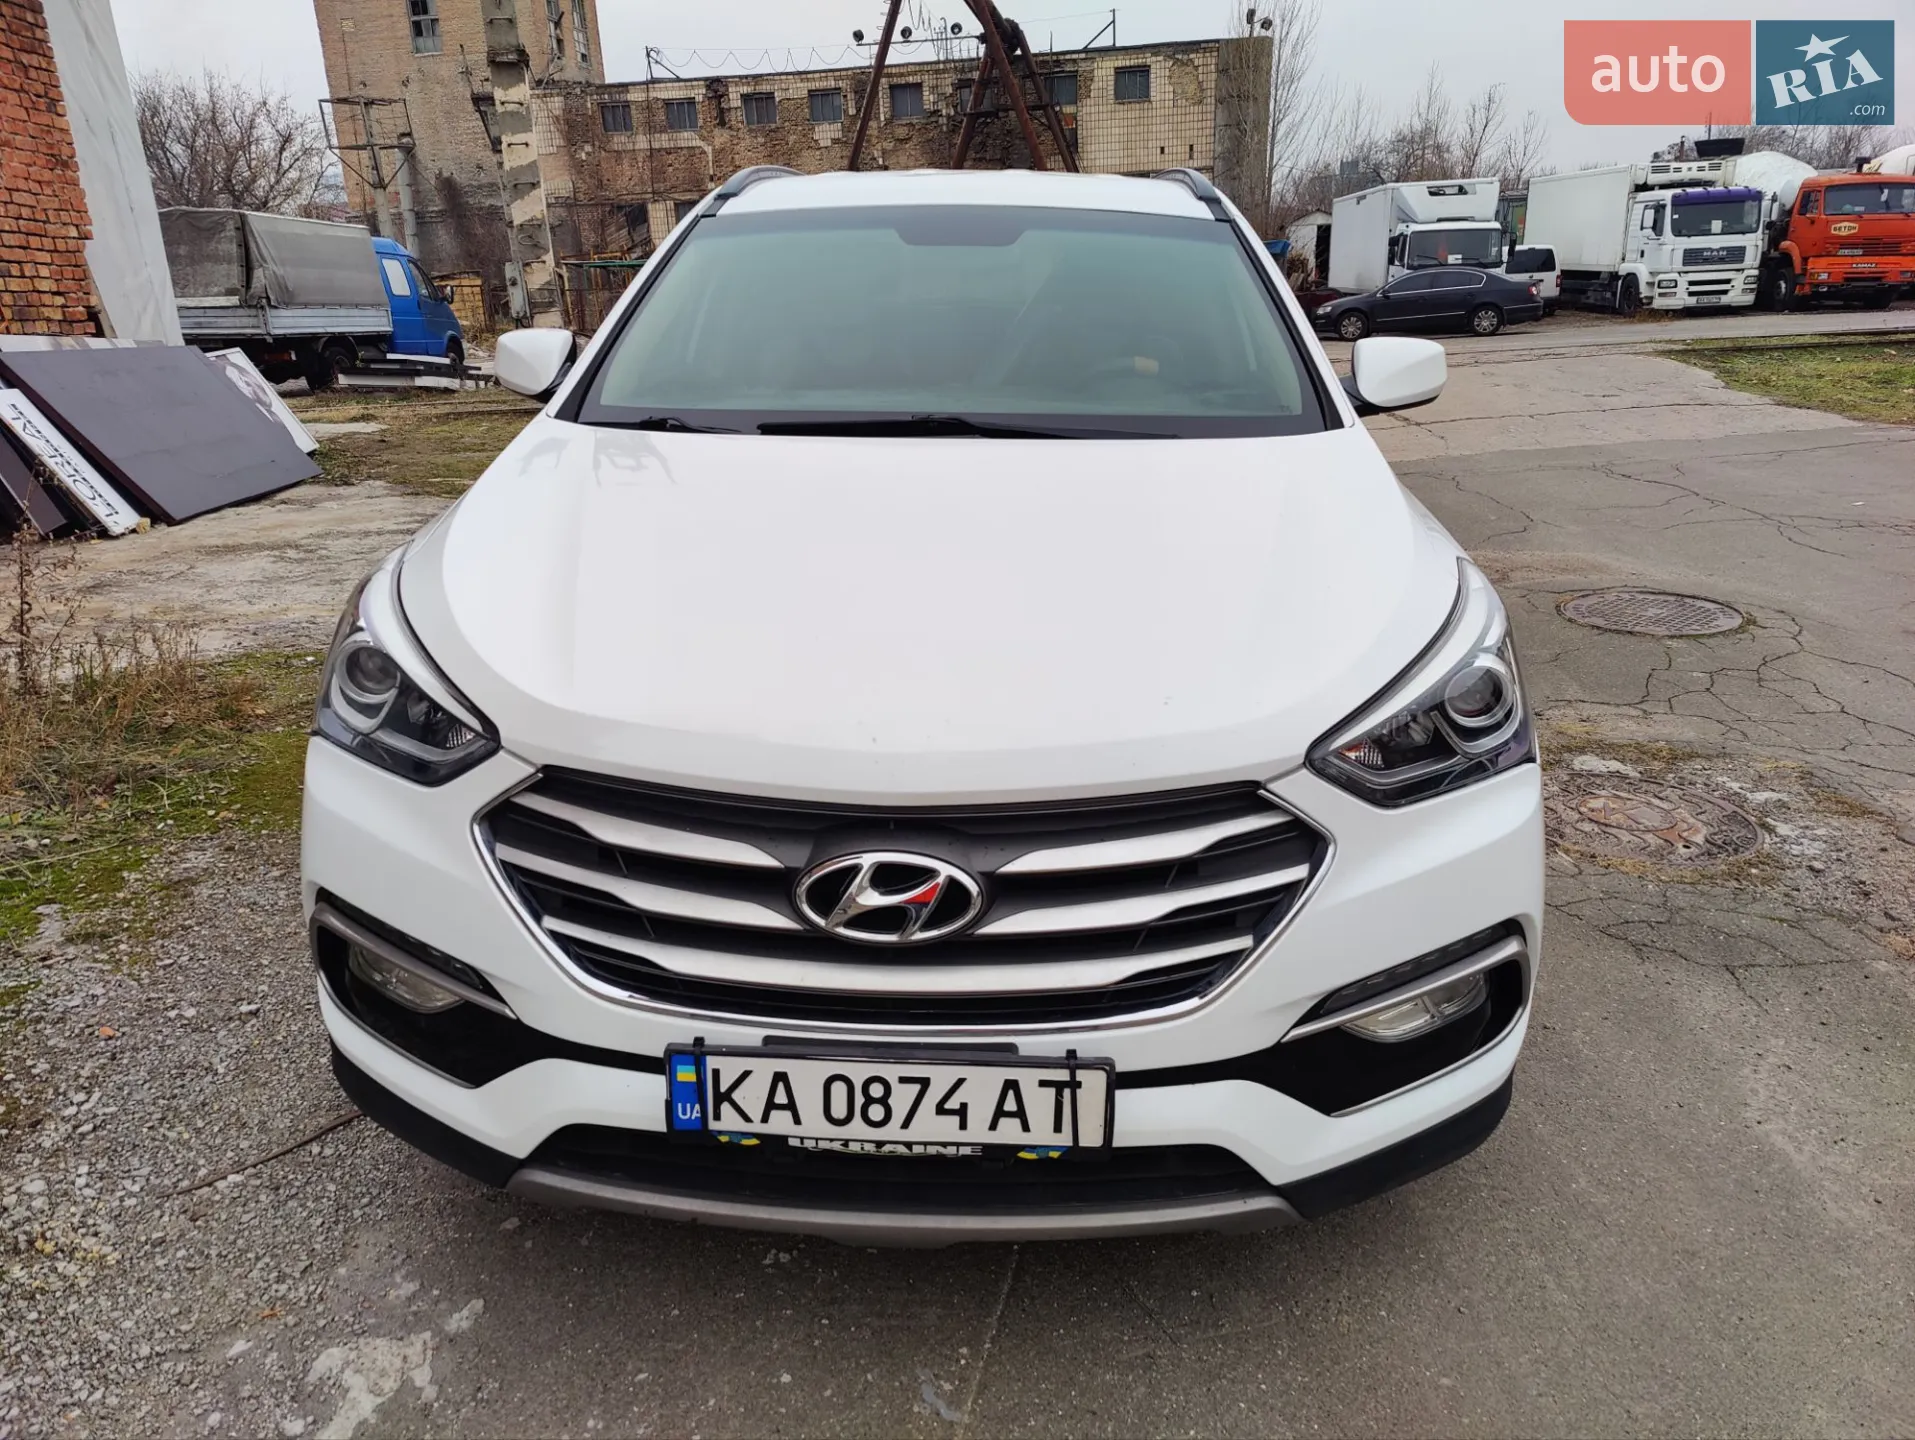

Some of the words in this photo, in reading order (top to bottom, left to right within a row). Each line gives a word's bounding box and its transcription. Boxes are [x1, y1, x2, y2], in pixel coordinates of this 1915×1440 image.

[677, 1102, 702, 1120] UA
[711, 1067, 803, 1126] KA
[821, 1073, 969, 1131] 0874
[987, 1078, 1083, 1134] AT
[787, 1136, 983, 1157] UKRAINE
